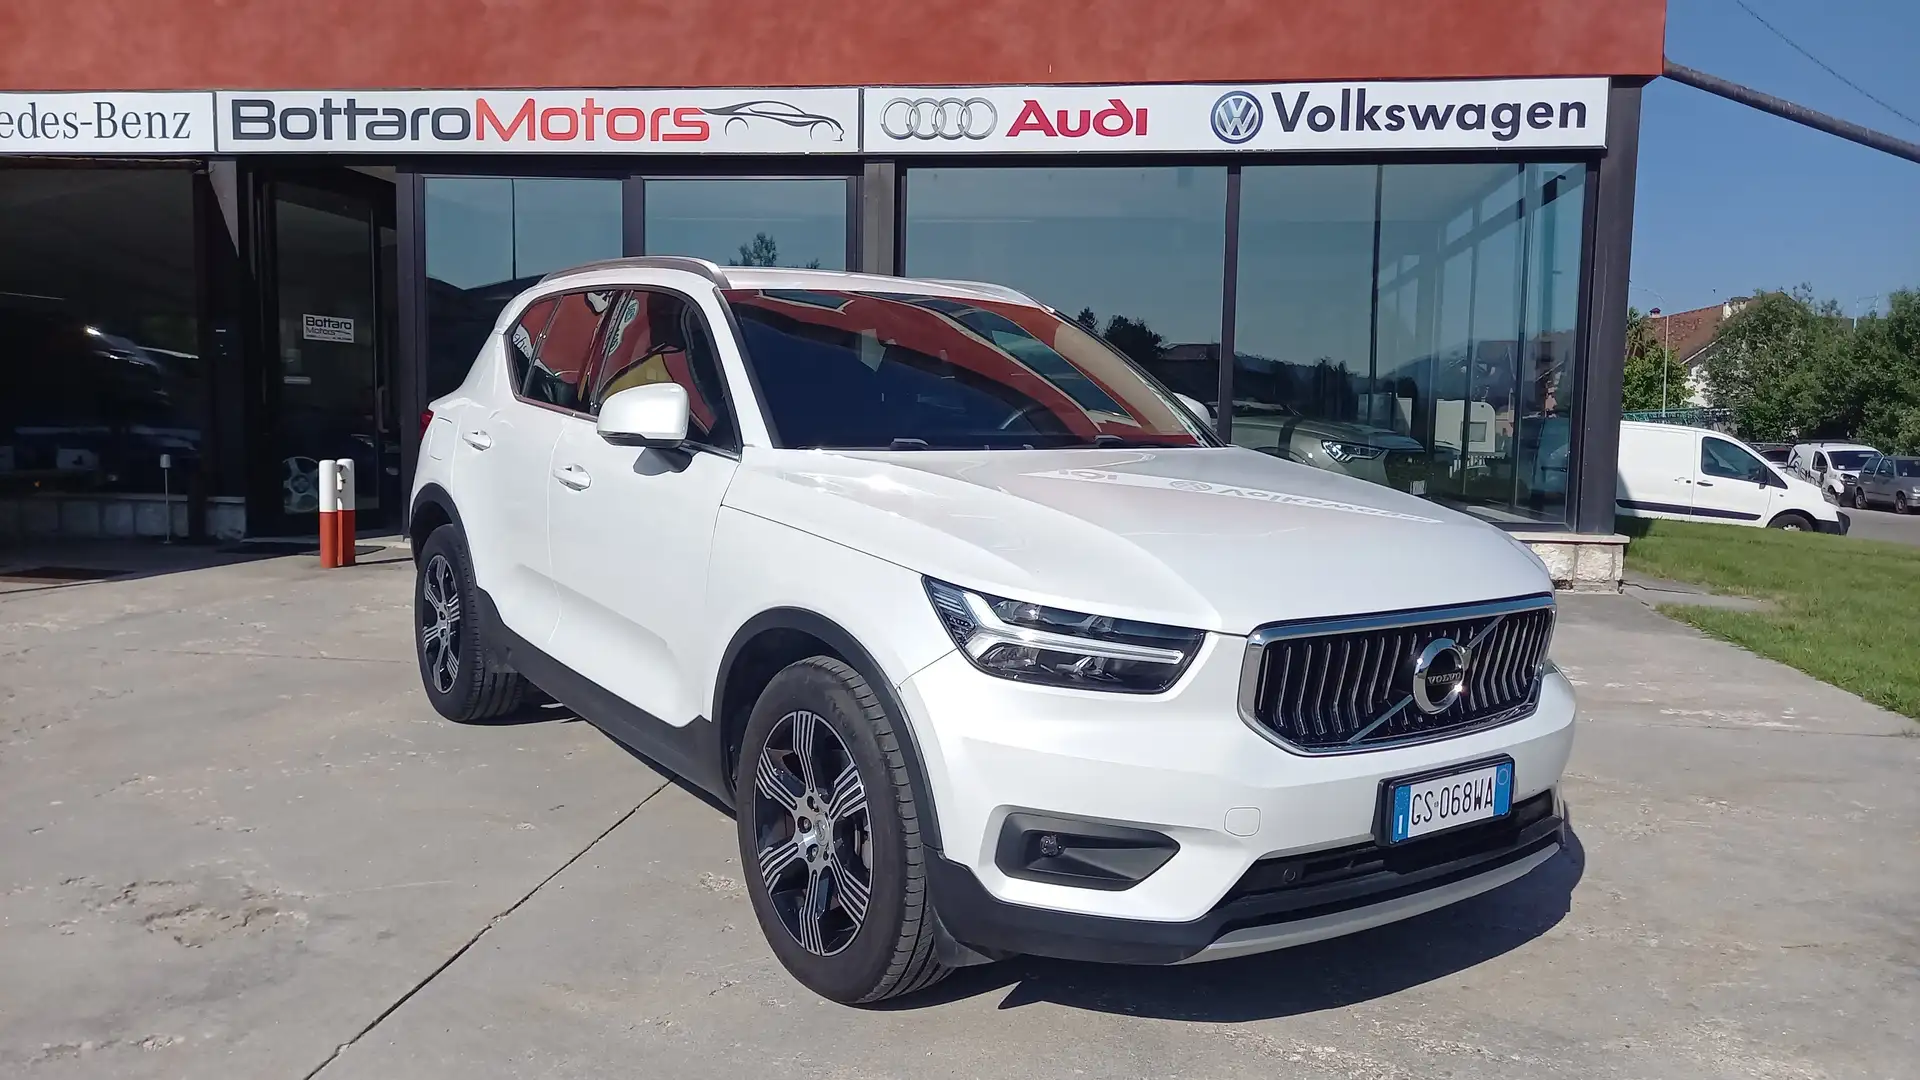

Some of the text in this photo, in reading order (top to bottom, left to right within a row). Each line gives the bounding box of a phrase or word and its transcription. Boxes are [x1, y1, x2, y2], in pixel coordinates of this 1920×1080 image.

[1005, 98, 1149, 138] Audi
[1270, 87, 1587, 142] Volkswagen
[305, 316, 352, 330] Bottaro
[1427, 672, 1462, 685] VOLVO
